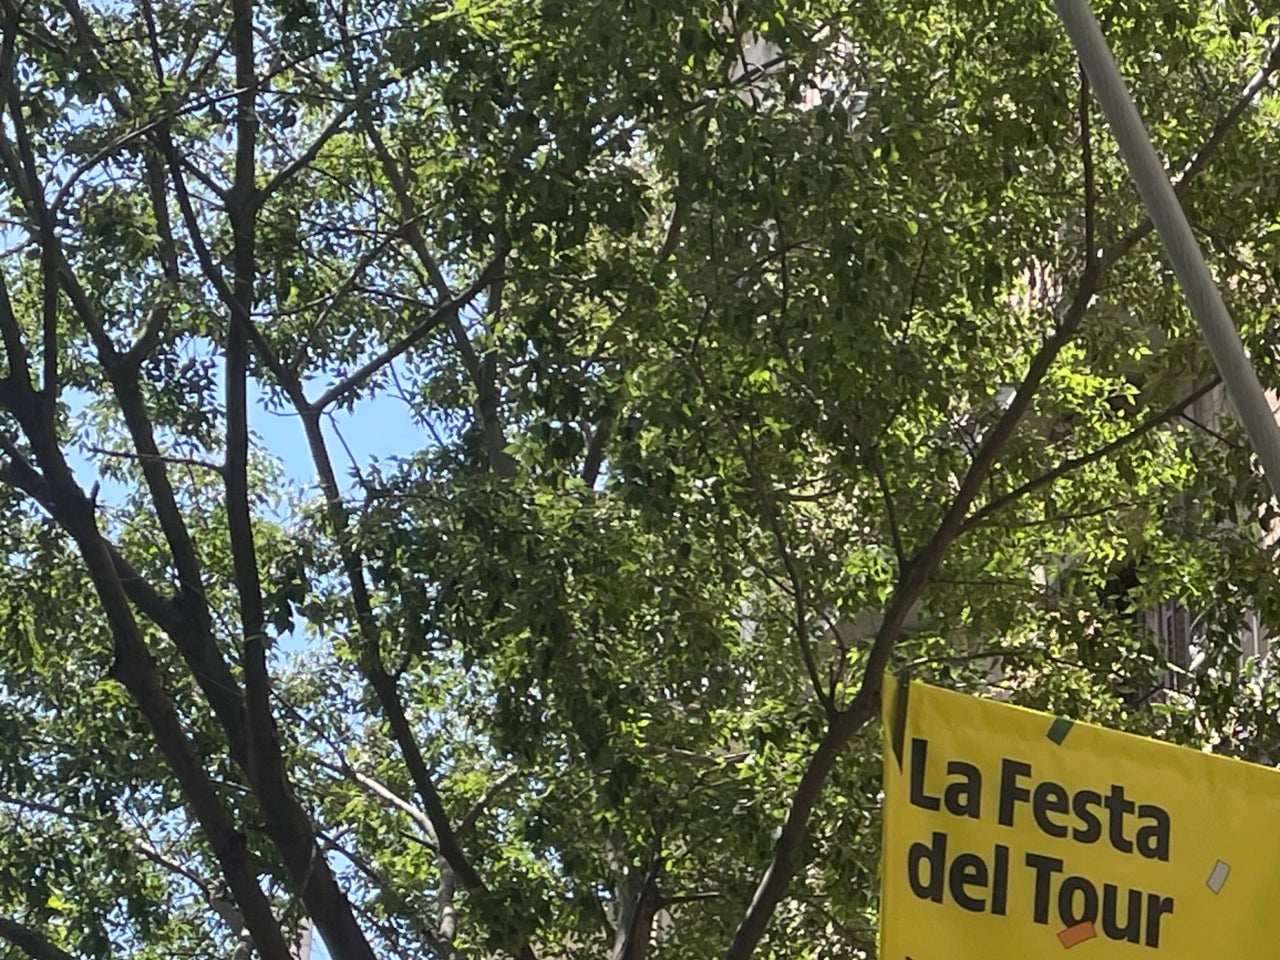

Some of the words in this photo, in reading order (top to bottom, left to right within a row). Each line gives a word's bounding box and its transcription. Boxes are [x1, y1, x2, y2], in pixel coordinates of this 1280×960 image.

[909, 737, 983, 820] La
[998, 757, 1172, 863] Festa
[907, 831, 1009, 916] del
[1025, 852, 1175, 949] Tour
